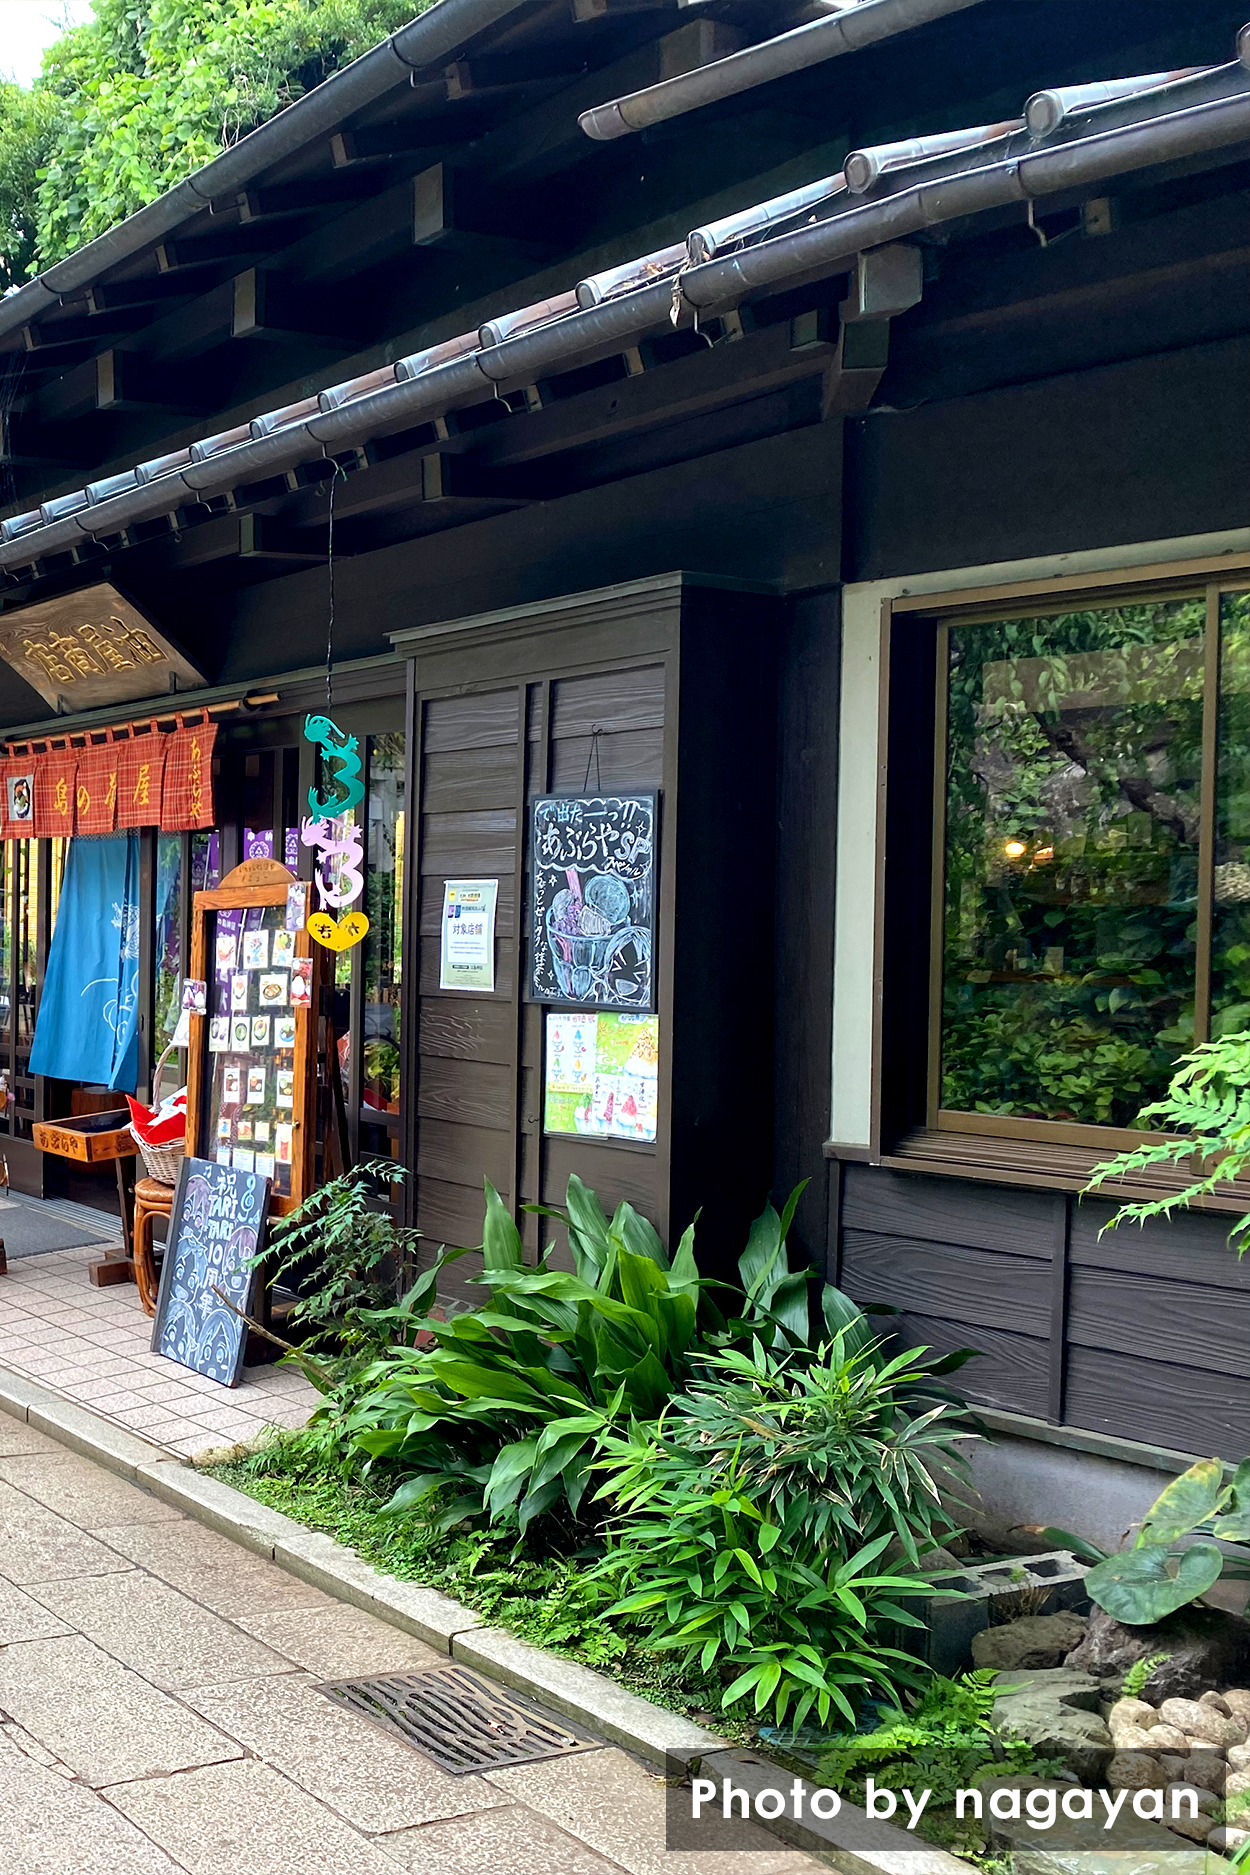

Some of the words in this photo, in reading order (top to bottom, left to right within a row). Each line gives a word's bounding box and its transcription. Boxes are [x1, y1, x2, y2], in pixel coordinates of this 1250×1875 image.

[23, 616, 169, 683] 油屋商店
[453, 923, 483, 935] 対象店舗
[217, 1168, 237, 1199] 祝
[208, 1194, 238, 1219] TARI
[207, 1219, 234, 1240] TARI
[208, 1241, 223, 1265] 10
